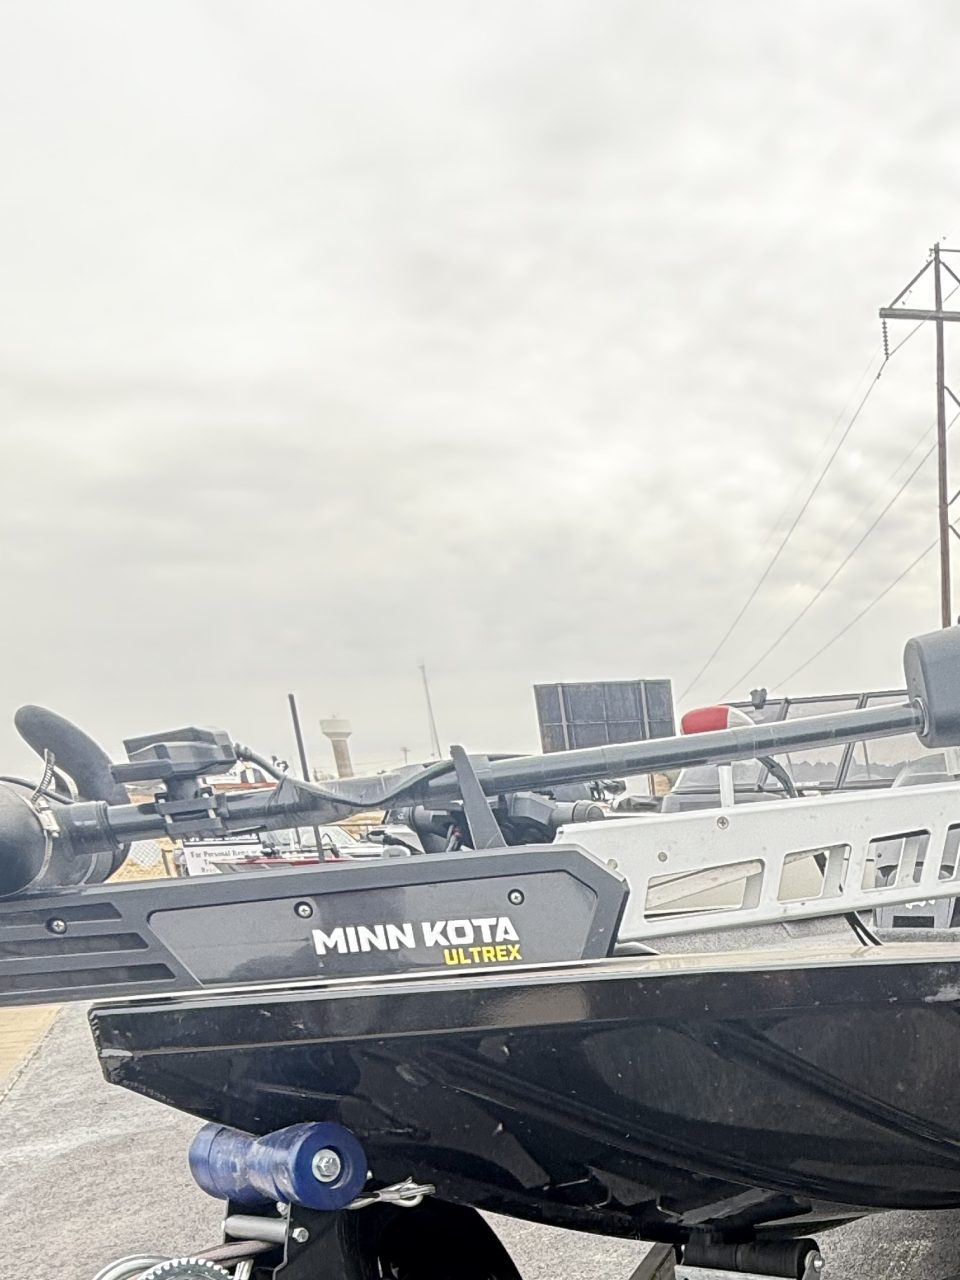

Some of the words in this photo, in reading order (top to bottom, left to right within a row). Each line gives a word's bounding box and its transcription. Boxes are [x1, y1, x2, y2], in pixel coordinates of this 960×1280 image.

[312, 923, 416, 955] MINN
[421, 916, 520, 947] KOTA
[444, 944, 523, 966] ULTREX
